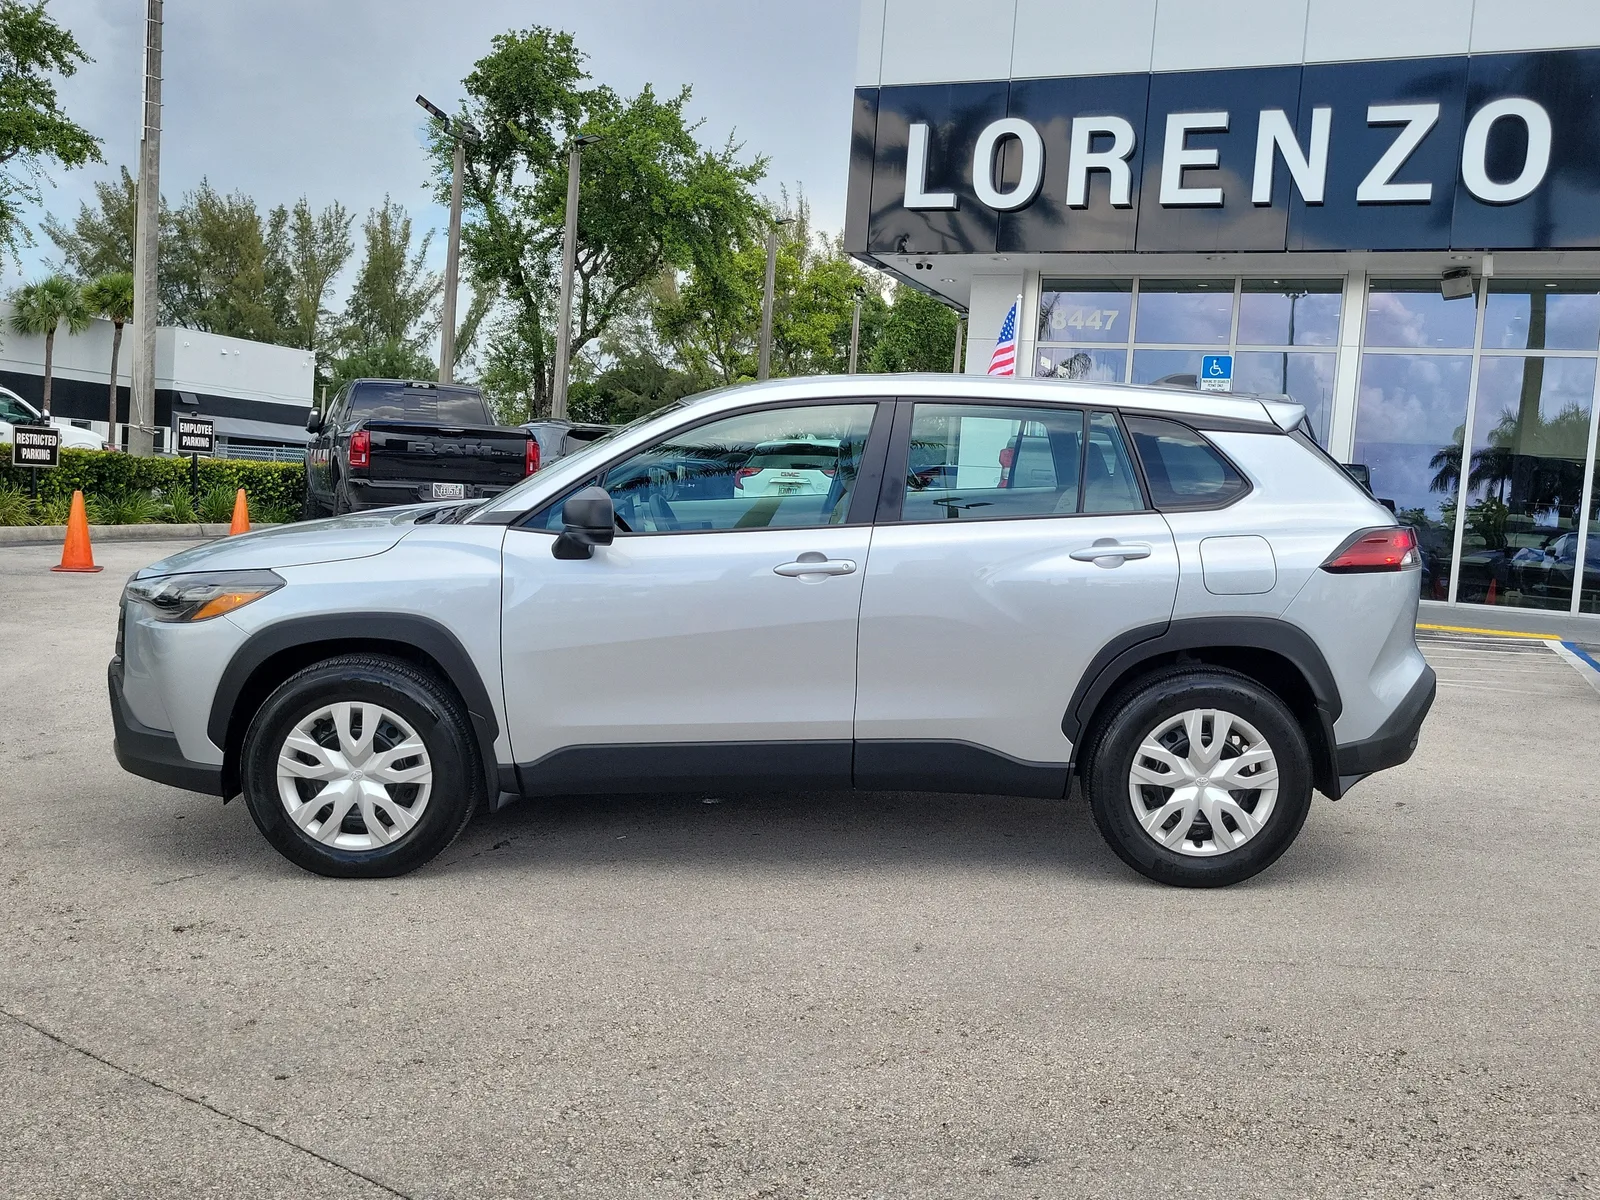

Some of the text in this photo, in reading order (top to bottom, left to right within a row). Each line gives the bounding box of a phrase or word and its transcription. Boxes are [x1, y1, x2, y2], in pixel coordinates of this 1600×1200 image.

[903, 98, 1552, 211] LORENZO
[1051, 310, 1119, 330] 8447
[179, 422, 213, 435] EMPLOYEE
[16, 432, 57, 446] RESTRICTED
[182, 436, 210, 448] PARKING
[21, 447, 51, 460] PARKING
[407, 441, 492, 456] RAM
